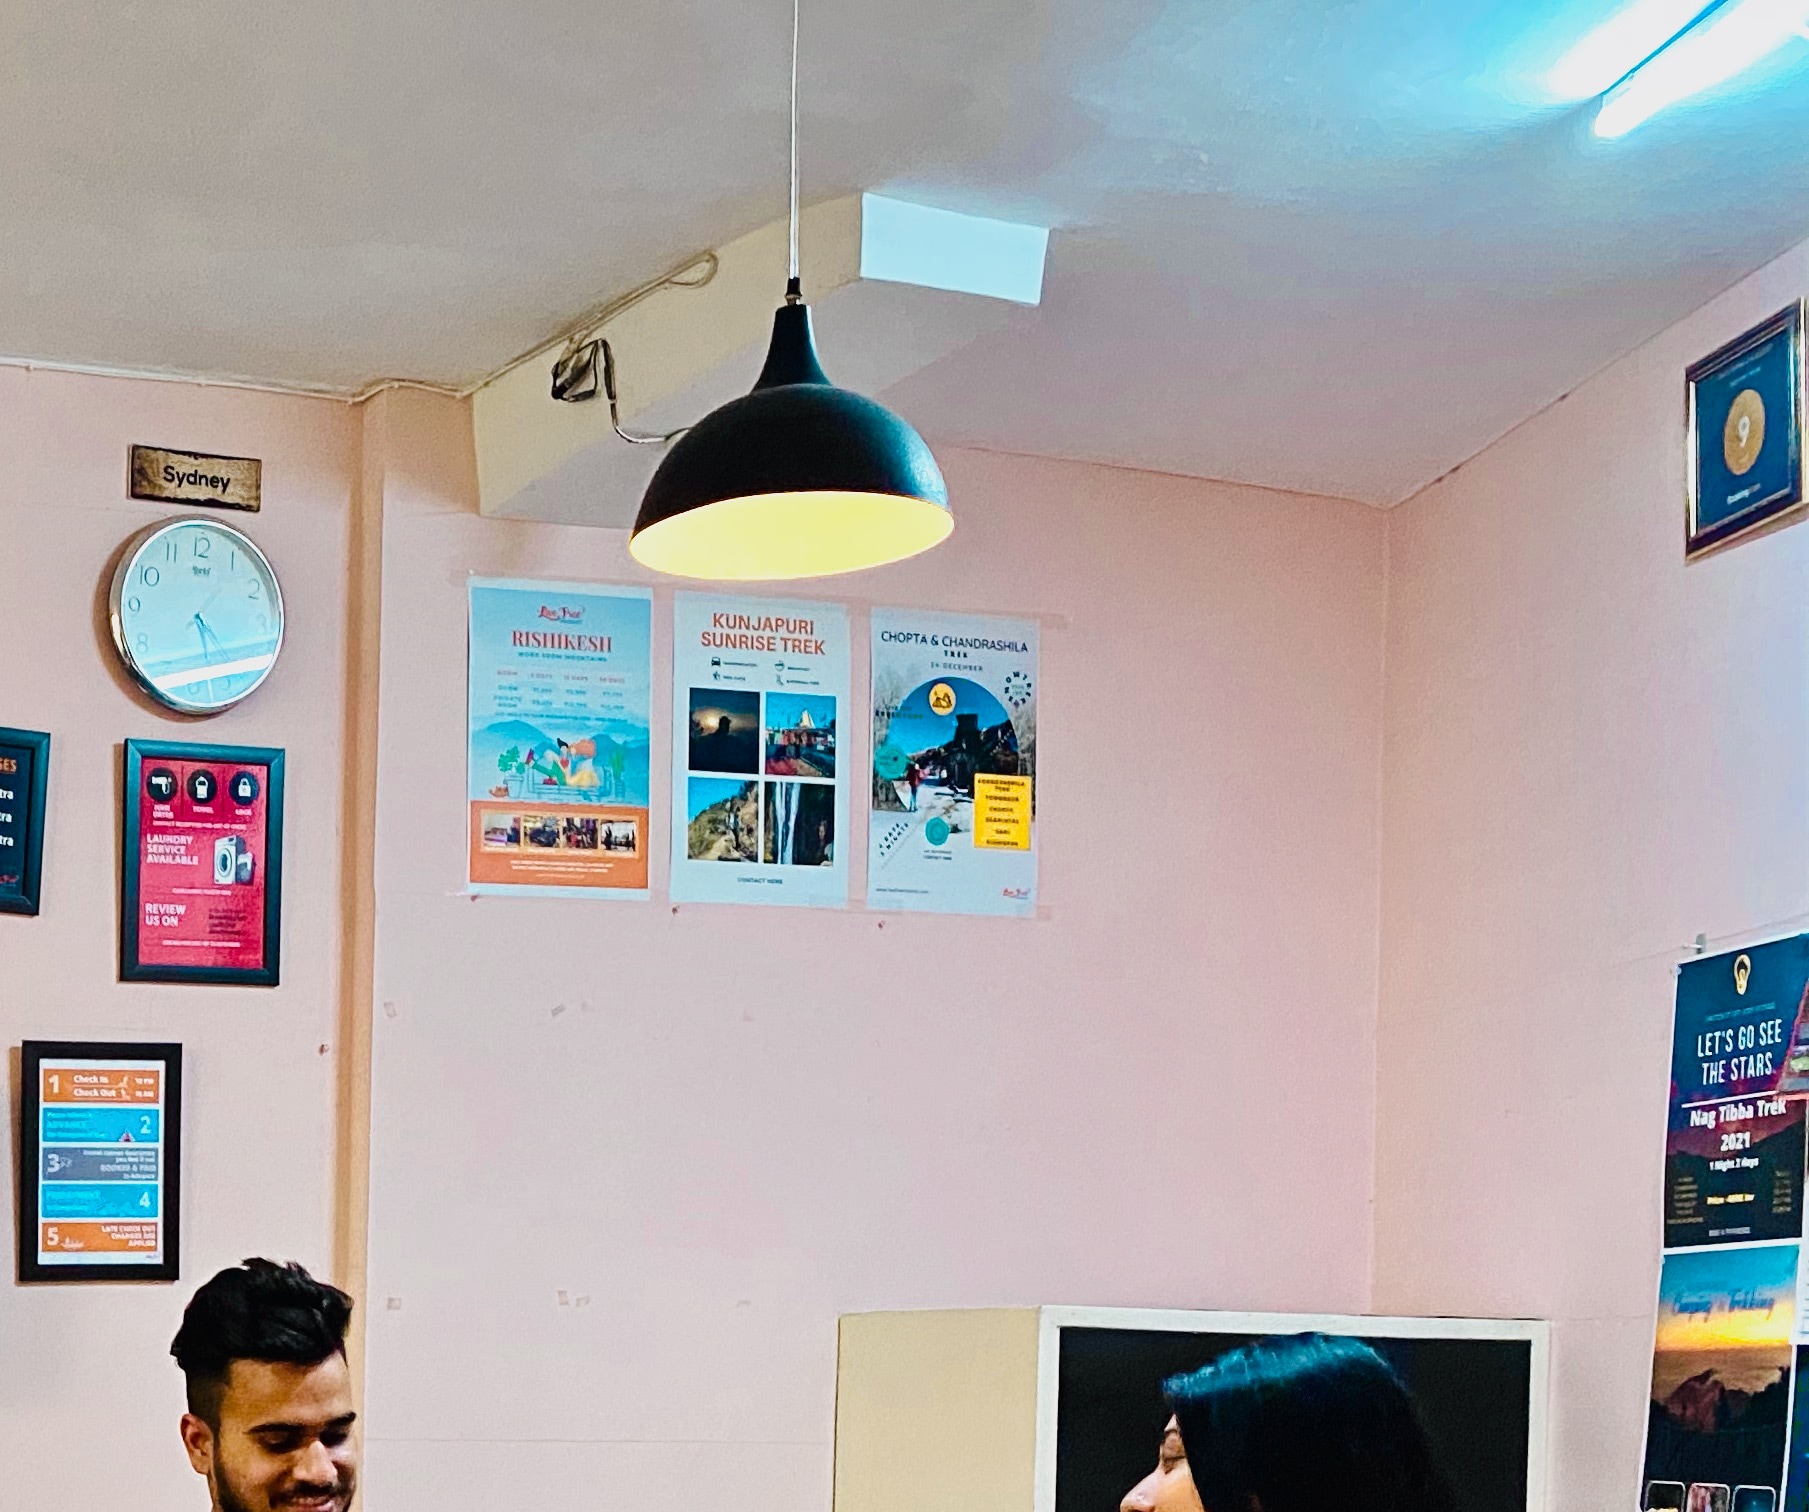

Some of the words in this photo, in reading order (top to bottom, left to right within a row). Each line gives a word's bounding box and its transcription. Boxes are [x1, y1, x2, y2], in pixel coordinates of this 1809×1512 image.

[163, 465, 230, 493] Sydney
[713, 612, 814, 636] KUNJAPURI
[512, 630, 612, 653] RISHIKESH
[702, 632, 776, 653] SUNRISE
[783, 636, 825, 655] TREK
[881, 631, 927, 645] CHOPTA
[930, 635, 938, 645] &
[942, 636, 1028, 652] CHANDRASHILA
[147, 834, 193, 844] LAUNDRY
[147, 844, 186, 854] SERVICE
[147, 855, 198, 865] AVAILABLE
[145, 903, 186, 915] REVIEW
[146, 915, 160, 926] US
[161, 916, 178, 927] ON
[1698, 1029, 1733, 1057] LET'S
[1738, 1025, 1754, 1050] GO
[1760, 1019, 1782, 1046] SEE
[73, 1075, 98, 1083] Check
[1702, 1060, 1726, 1085] THE
[49, 1075, 59, 1093] 1
[73, 1088, 99, 1096] Check
[100, 1089, 116, 1097] Out
[1690, 1110, 1716, 1129] Nag
[1719, 1103, 1754, 1123] Tibba
[1757, 1100, 1786, 1117] Trek
[140, 1116, 150, 1134] 2
[1720, 1132, 1751, 1151] 2021
[48, 1154, 59, 1173] 3
[139, 1192, 150, 1207] 4
[47, 1227, 59, 1246] 5
